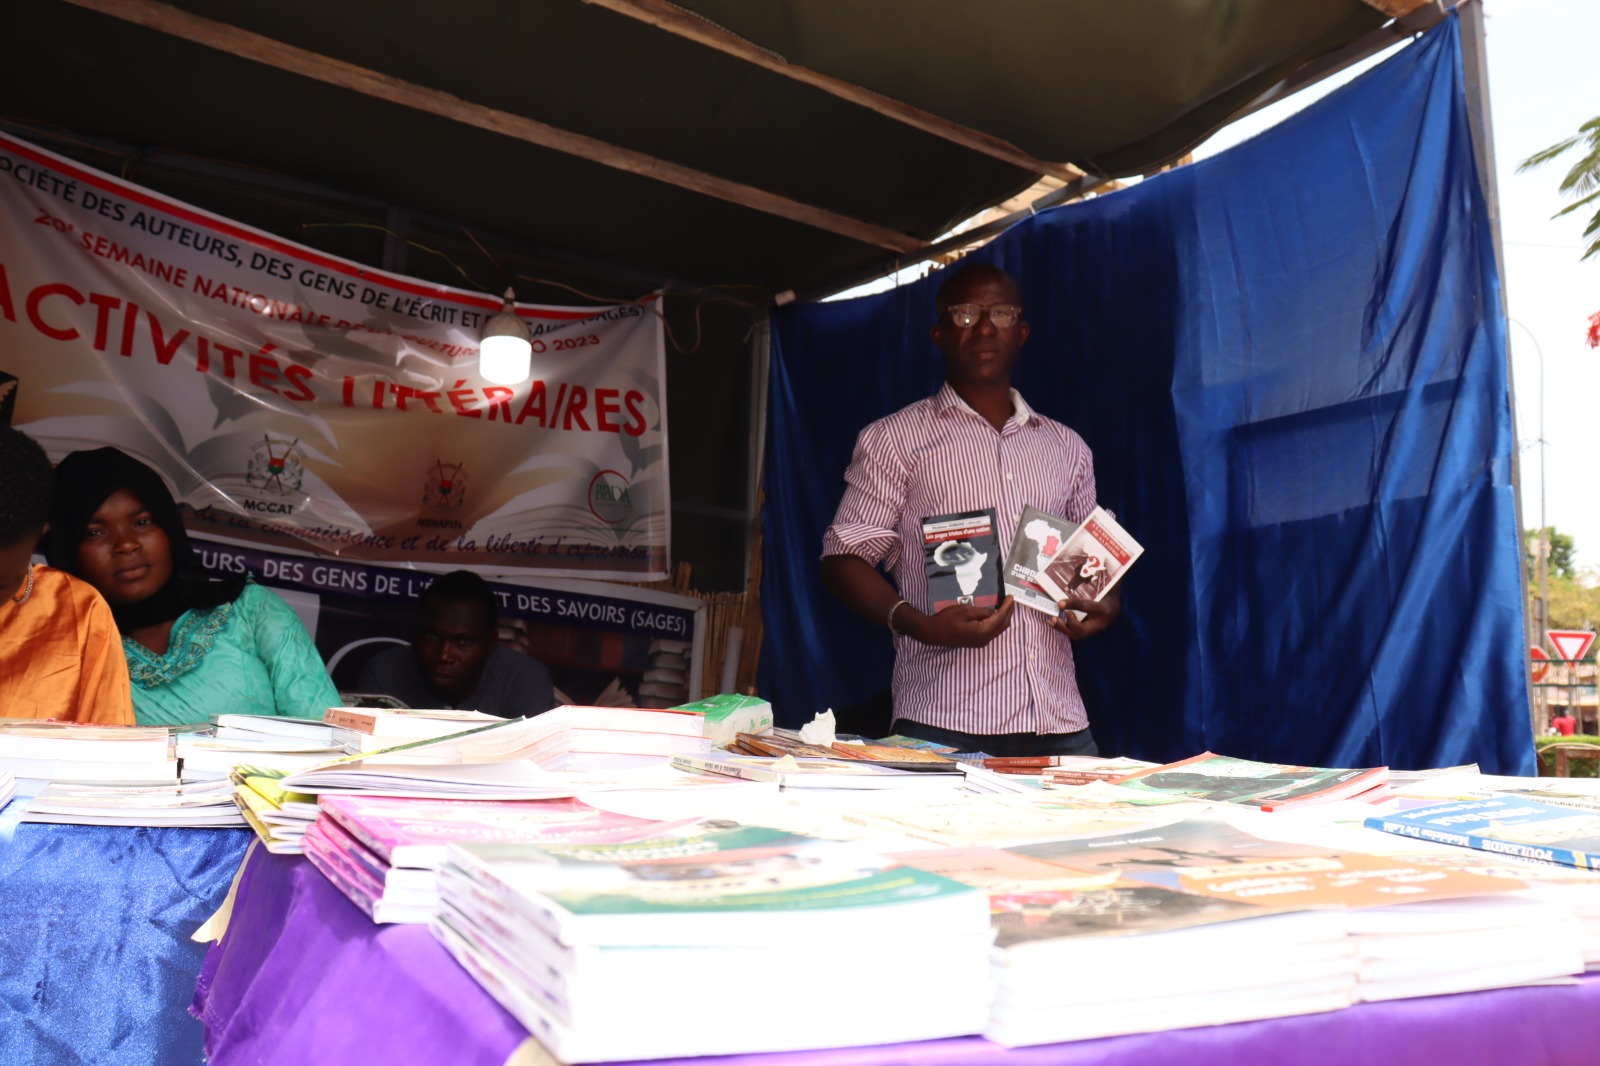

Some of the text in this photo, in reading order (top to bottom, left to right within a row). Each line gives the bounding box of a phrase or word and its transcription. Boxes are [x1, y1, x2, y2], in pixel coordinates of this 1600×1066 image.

[82, 190, 126, 222] DES
[129, 211, 244, 268] AUTEURS,
[250, 252, 294, 281] DES
[299, 269, 356, 299] GENS
[360, 287, 389, 309] DE
[392, 296, 458, 324] L'ÉCRIT
[461, 311, 481, 328] ET
[79, 232, 189, 289] SEMAINE
[192, 274, 330, 327] NATIONALE
[552, 334, 600, 351] 2023
[342, 376, 647, 437] LITTÉRAIRES
[595, 483, 633, 506] BBDA
[242, 499, 293, 515] MCCAT
[401, 535, 419, 551] et
[426, 533, 449, 551] de
[457, 535, 477, 552] la
[486, 533, 545, 554] liberté
[263, 559, 304, 582] DES
[312, 566, 368, 591] GENS
[374, 578, 401, 595] DE
[517, 595, 551, 614] DES
[557, 600, 626, 624] SAVOIRS
[630, 607, 687, 636] (SAGES)
[1406, 825, 1420, 838] De
[1421, 829, 1470, 848] Madeleine
